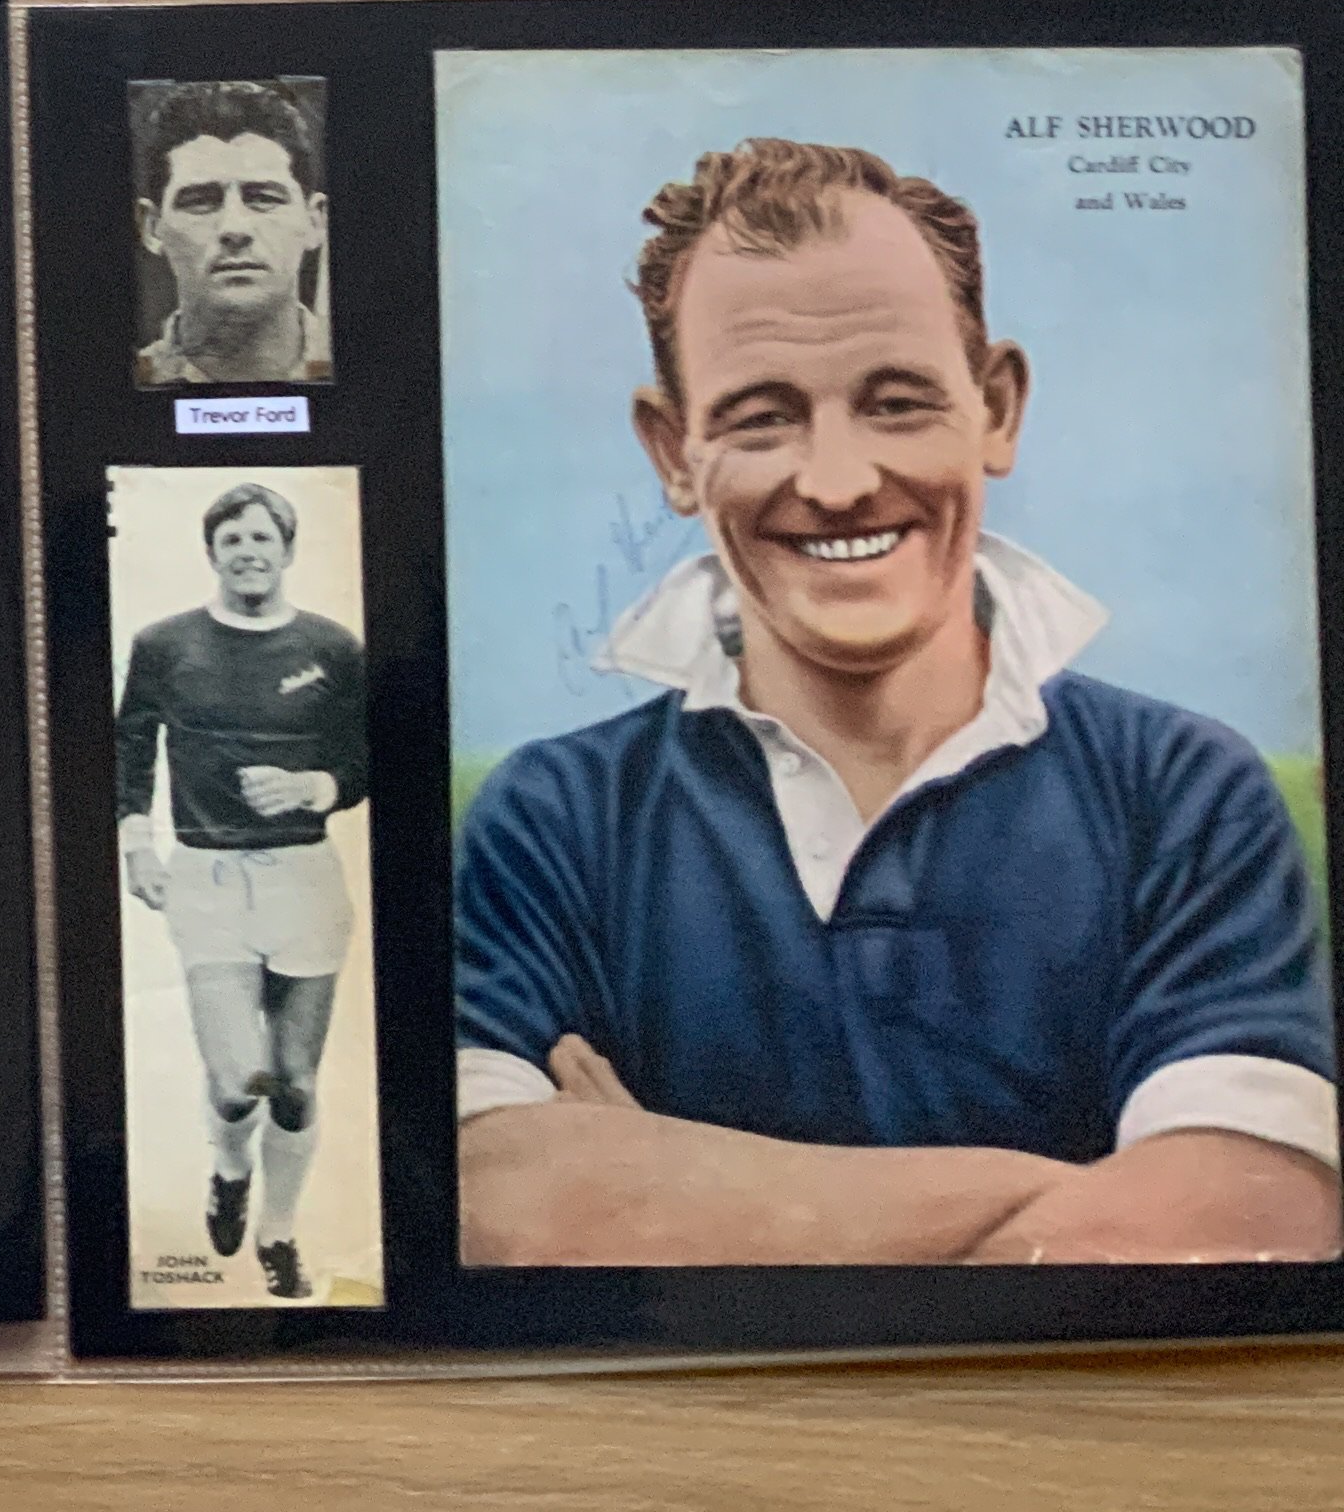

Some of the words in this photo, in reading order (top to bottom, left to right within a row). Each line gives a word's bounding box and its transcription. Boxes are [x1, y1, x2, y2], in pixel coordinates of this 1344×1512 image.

[1003, 114, 1064, 139] ALF
[1076, 114, 1258, 140] SHERWOOD
[1067, 154, 1140, 174] Cardiff
[1148, 154, 1192, 176] City
[1074, 192, 1114, 211] and
[1121, 191, 1187, 210] Wales
[188, 406, 250, 424] Trevor
[255, 405, 297, 423] Ford
[155, 1254, 209, 1269] JOHN
[140, 1270, 225, 1285] TOSHACK
